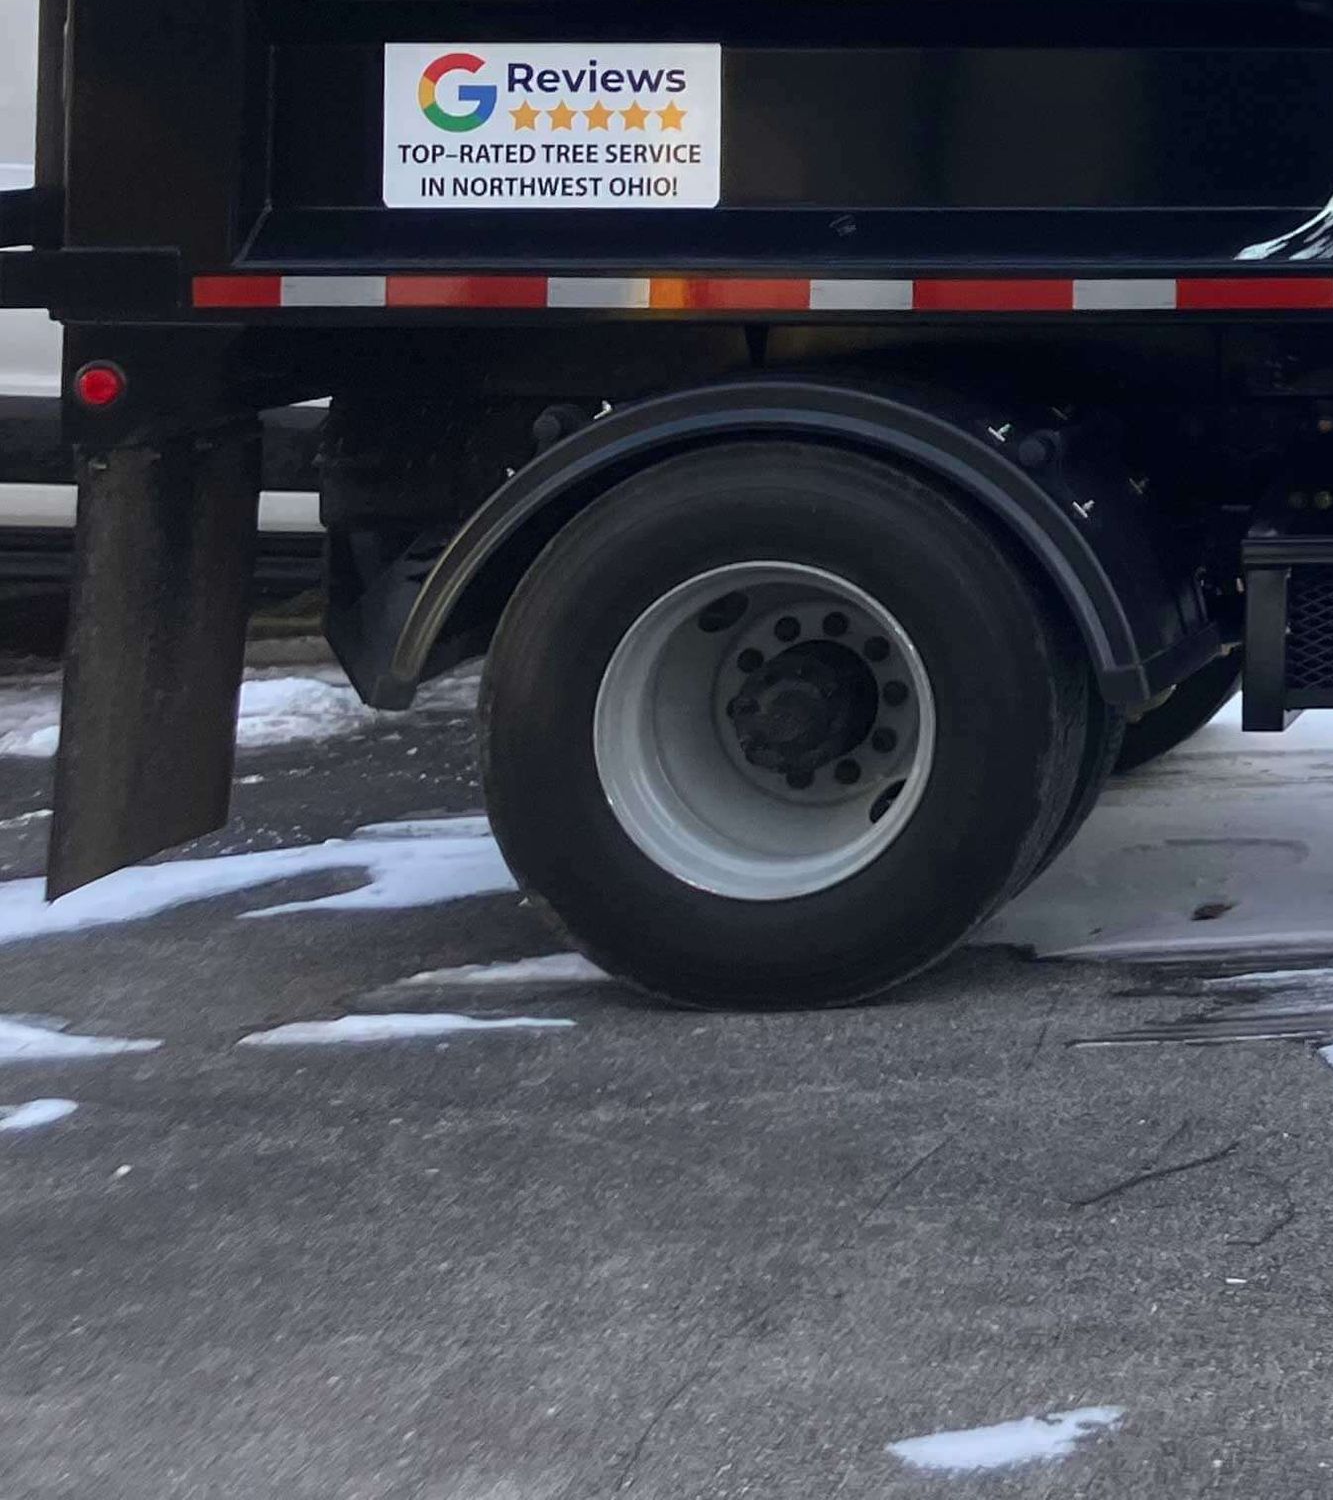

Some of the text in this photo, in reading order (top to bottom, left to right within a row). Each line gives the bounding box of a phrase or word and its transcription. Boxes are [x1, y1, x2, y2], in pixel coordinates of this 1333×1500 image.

[418, 52, 687, 133] G Reviews
[398, 143, 702, 164] TOP-RATED TREE SERVICE
[420, 177, 678, 197] IN NORTHWEST OHIO!
